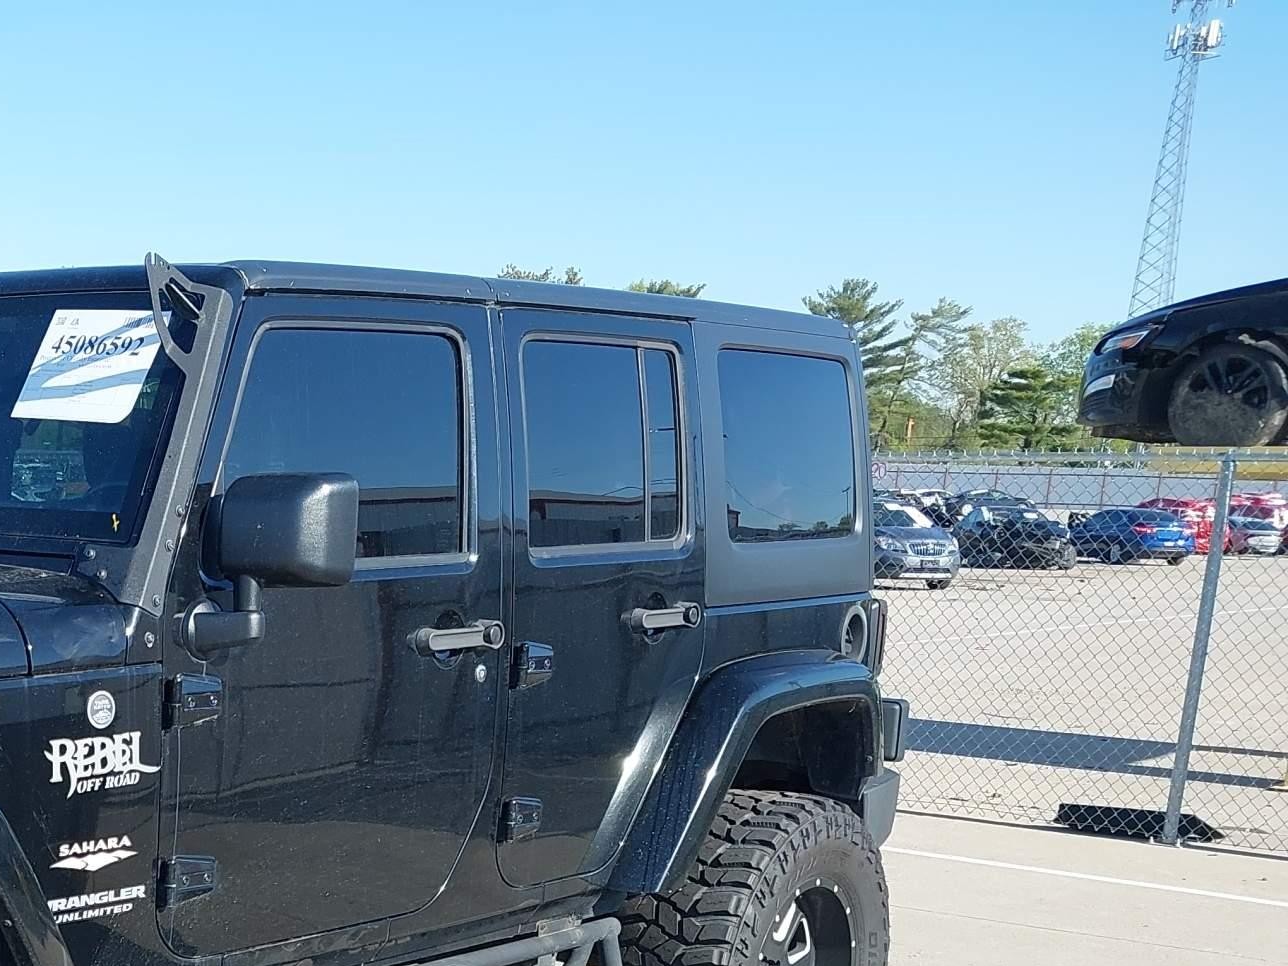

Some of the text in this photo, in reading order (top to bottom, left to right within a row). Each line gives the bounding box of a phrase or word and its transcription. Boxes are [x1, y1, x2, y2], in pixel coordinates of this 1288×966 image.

[51, 335, 145, 357] 45086592
[44, 731, 161, 799] REBEL
[77, 772, 140, 794] OFF ROAD
[59, 835, 132, 857] SAHARA
[54, 903, 133, 924] UNLIMITED
